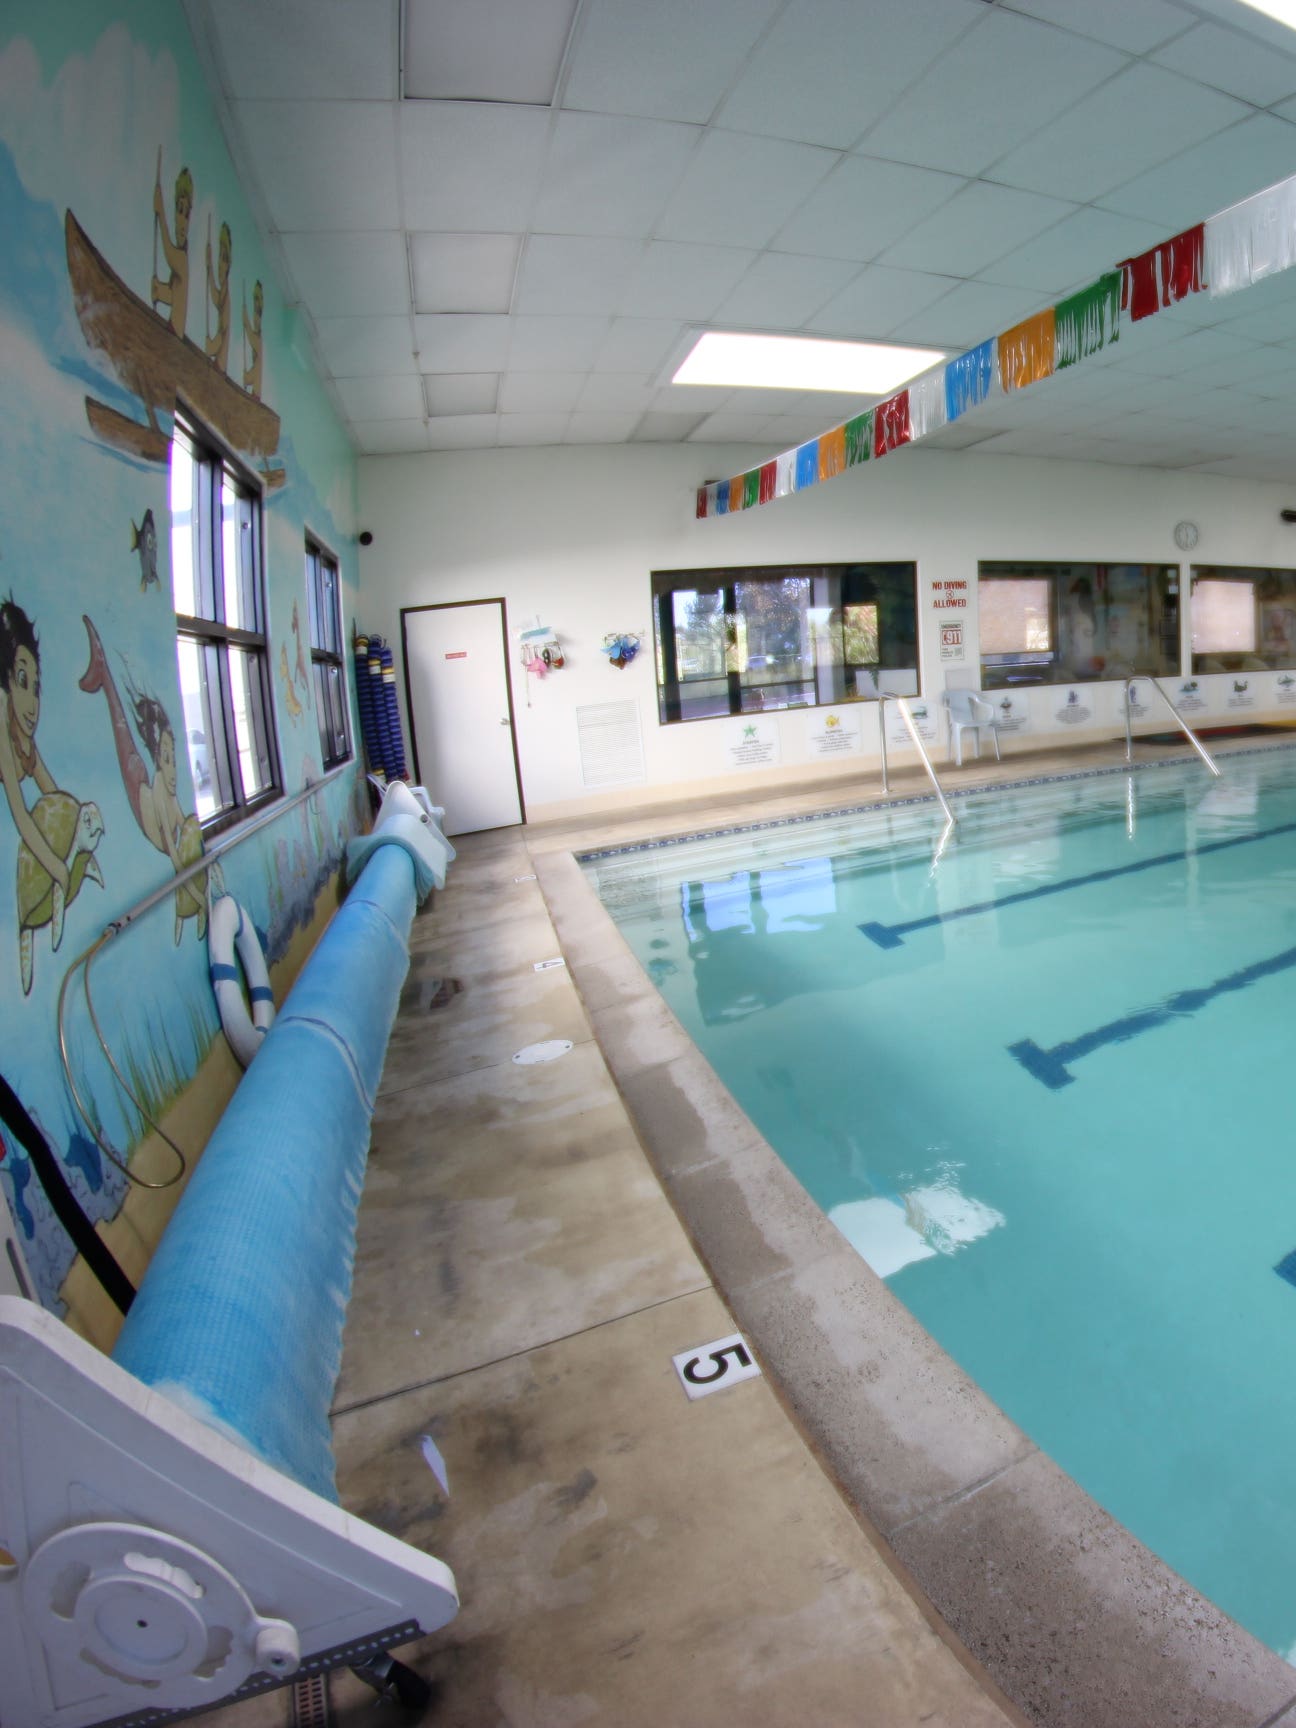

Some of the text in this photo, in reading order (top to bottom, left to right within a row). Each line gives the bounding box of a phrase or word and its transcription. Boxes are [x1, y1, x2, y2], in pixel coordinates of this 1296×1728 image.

[932, 581, 967, 590] NO DIVING
[933, 599, 966, 608] ALLOWED
[947, 631, 961, 644] 911
[683, 1342, 752, 1385] 5
